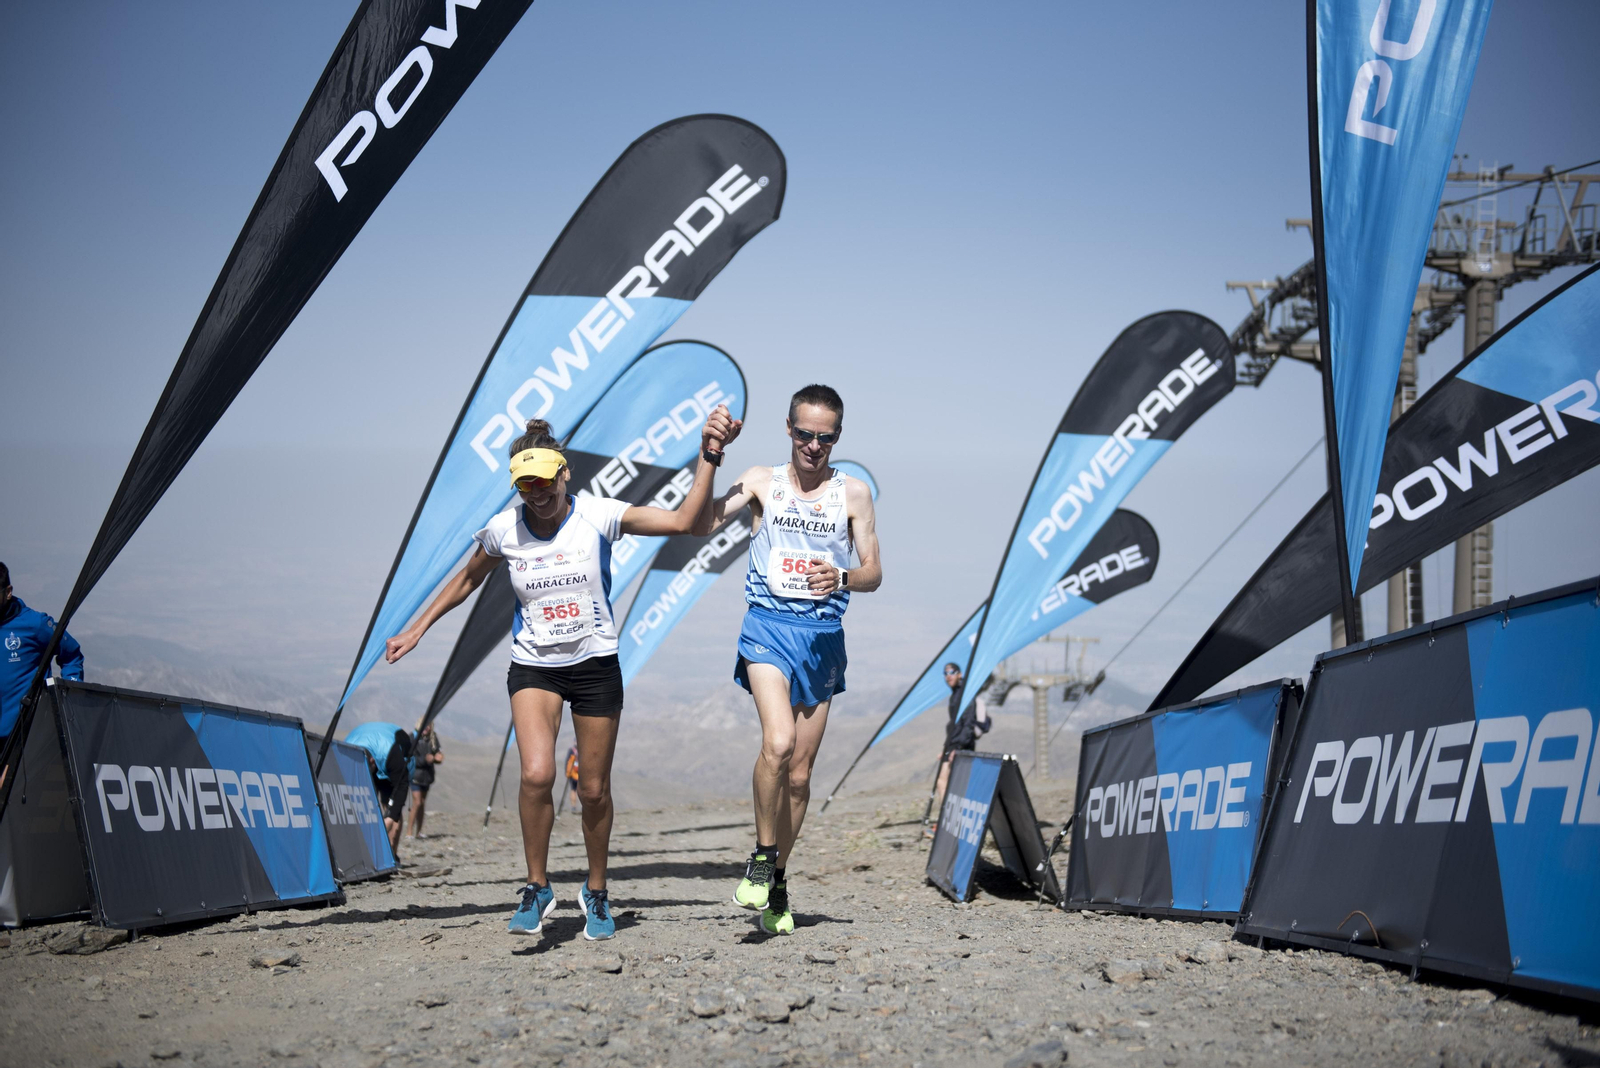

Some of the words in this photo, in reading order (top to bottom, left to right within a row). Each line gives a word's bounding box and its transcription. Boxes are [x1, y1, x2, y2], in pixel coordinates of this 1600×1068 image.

[470, 164, 762, 473] POWERADE
[577, 380, 735, 498] ERADE
[1028, 348, 1218, 560] POWERADE
[772, 515, 836, 533] MARACENA
[778, 550, 808, 559] RELEVOS
[526, 574, 588, 590] MARACENA
[536, 598, 565, 607] RELEVOS
[542, 602, 580, 621] 568
[629, 520, 748, 646] POWERADE
[1031, 544, 1145, 622] ERADE
[553, 620, 579, 628] HIELOS
[93, 763, 307, 833] POWERADE
[1085, 761, 1252, 839] POWERADE
